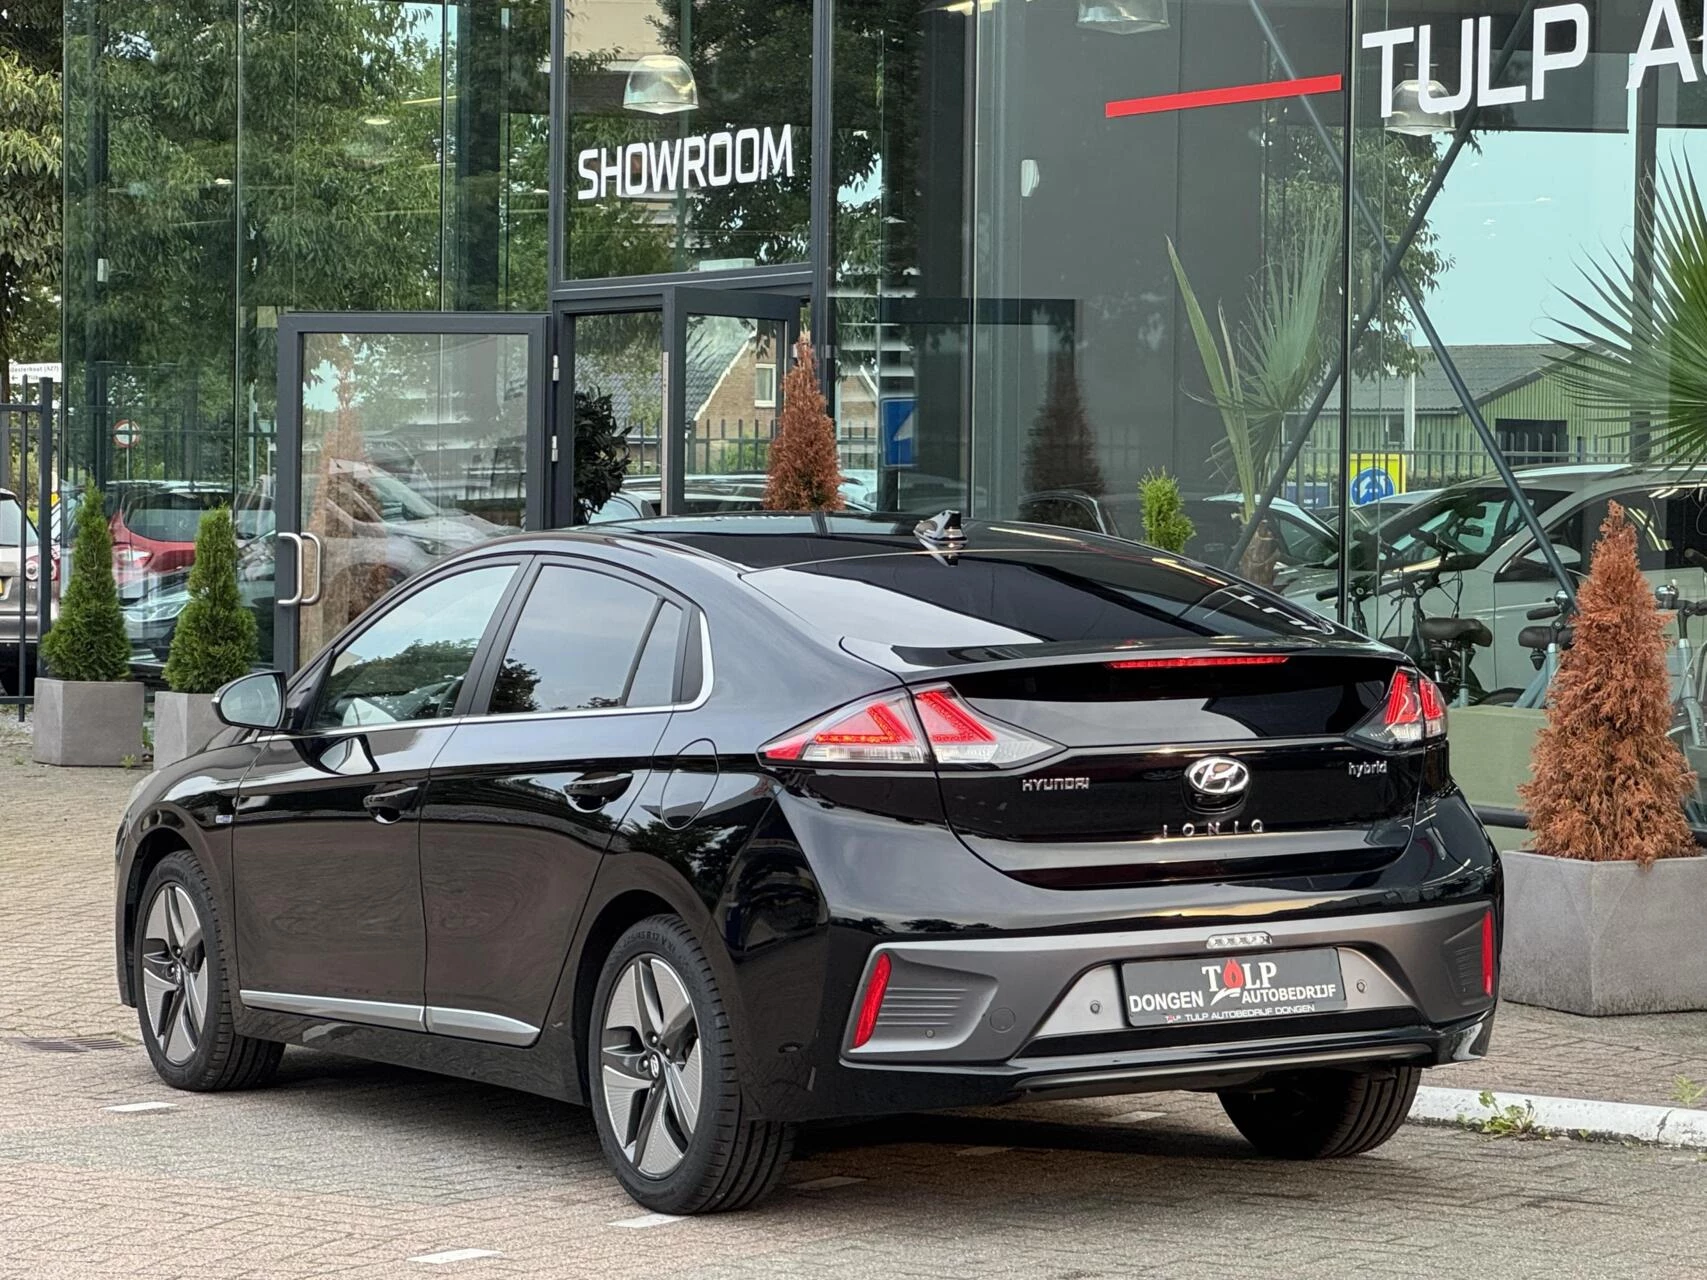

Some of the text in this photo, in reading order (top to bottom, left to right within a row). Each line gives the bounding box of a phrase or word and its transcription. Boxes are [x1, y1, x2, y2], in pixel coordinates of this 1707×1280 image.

[1362, 0, 1707, 118] TULP A
[578, 124, 794, 200] SHOWROOM
[1348, 760, 1388, 778] hybrid
[1022, 776, 1090, 792] HYUNDAI
[1162, 818, 1265, 837] IONIQ
[1129, 990, 1204, 1012] DONGEN
[1241, 984, 1337, 1004] AUTOBEDRIJF
[1184, 1012, 1209, 1022] TULP
[1211, 1008, 1273, 1020] AUTOBEDRIJF
[1274, 1004, 1316, 1016] DONGEN
